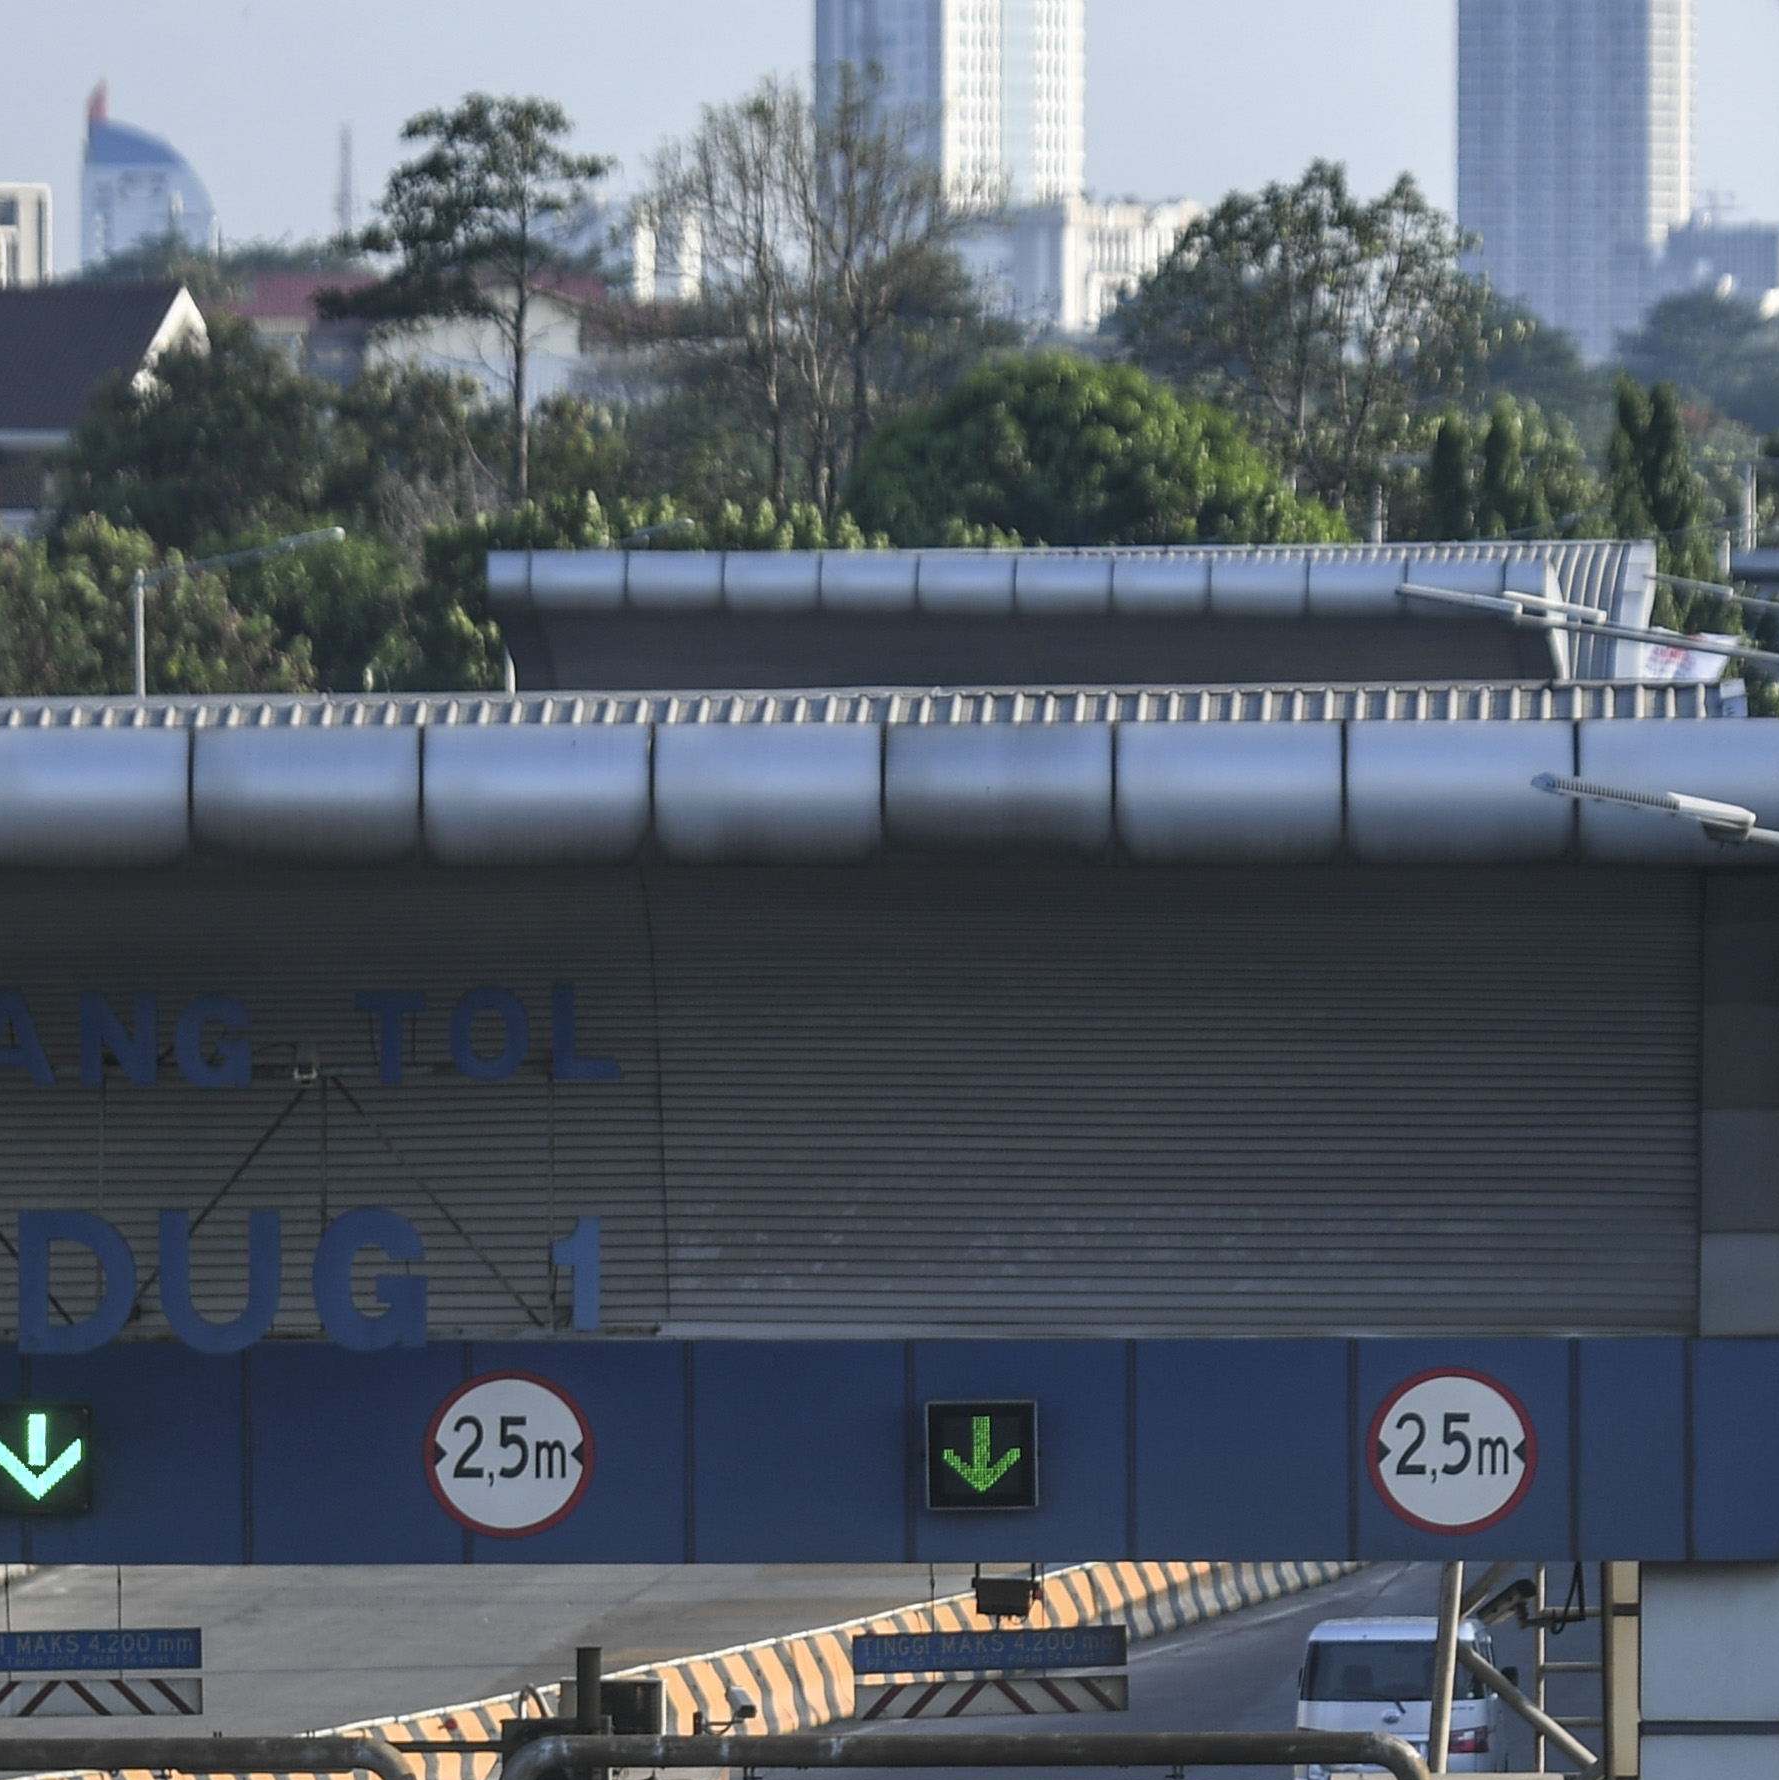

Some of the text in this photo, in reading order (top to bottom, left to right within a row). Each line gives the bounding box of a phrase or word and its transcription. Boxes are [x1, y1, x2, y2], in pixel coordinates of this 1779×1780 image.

[354, 985, 620, 1086] TOL
[552, 1217, 602, 1332] 1
[452, 1415, 568, 1486] 2,5m
[1393, 1412, 1511, 1482] 2,5m
[16, 1635, 80, 1654] MAKS
[89, 1633, 151, 1653] 4.200
[157, 1636, 194, 1651] mm
[860, 1637, 931, 1656] TINGGI
[941, 1634, 1005, 1653] MAKS
